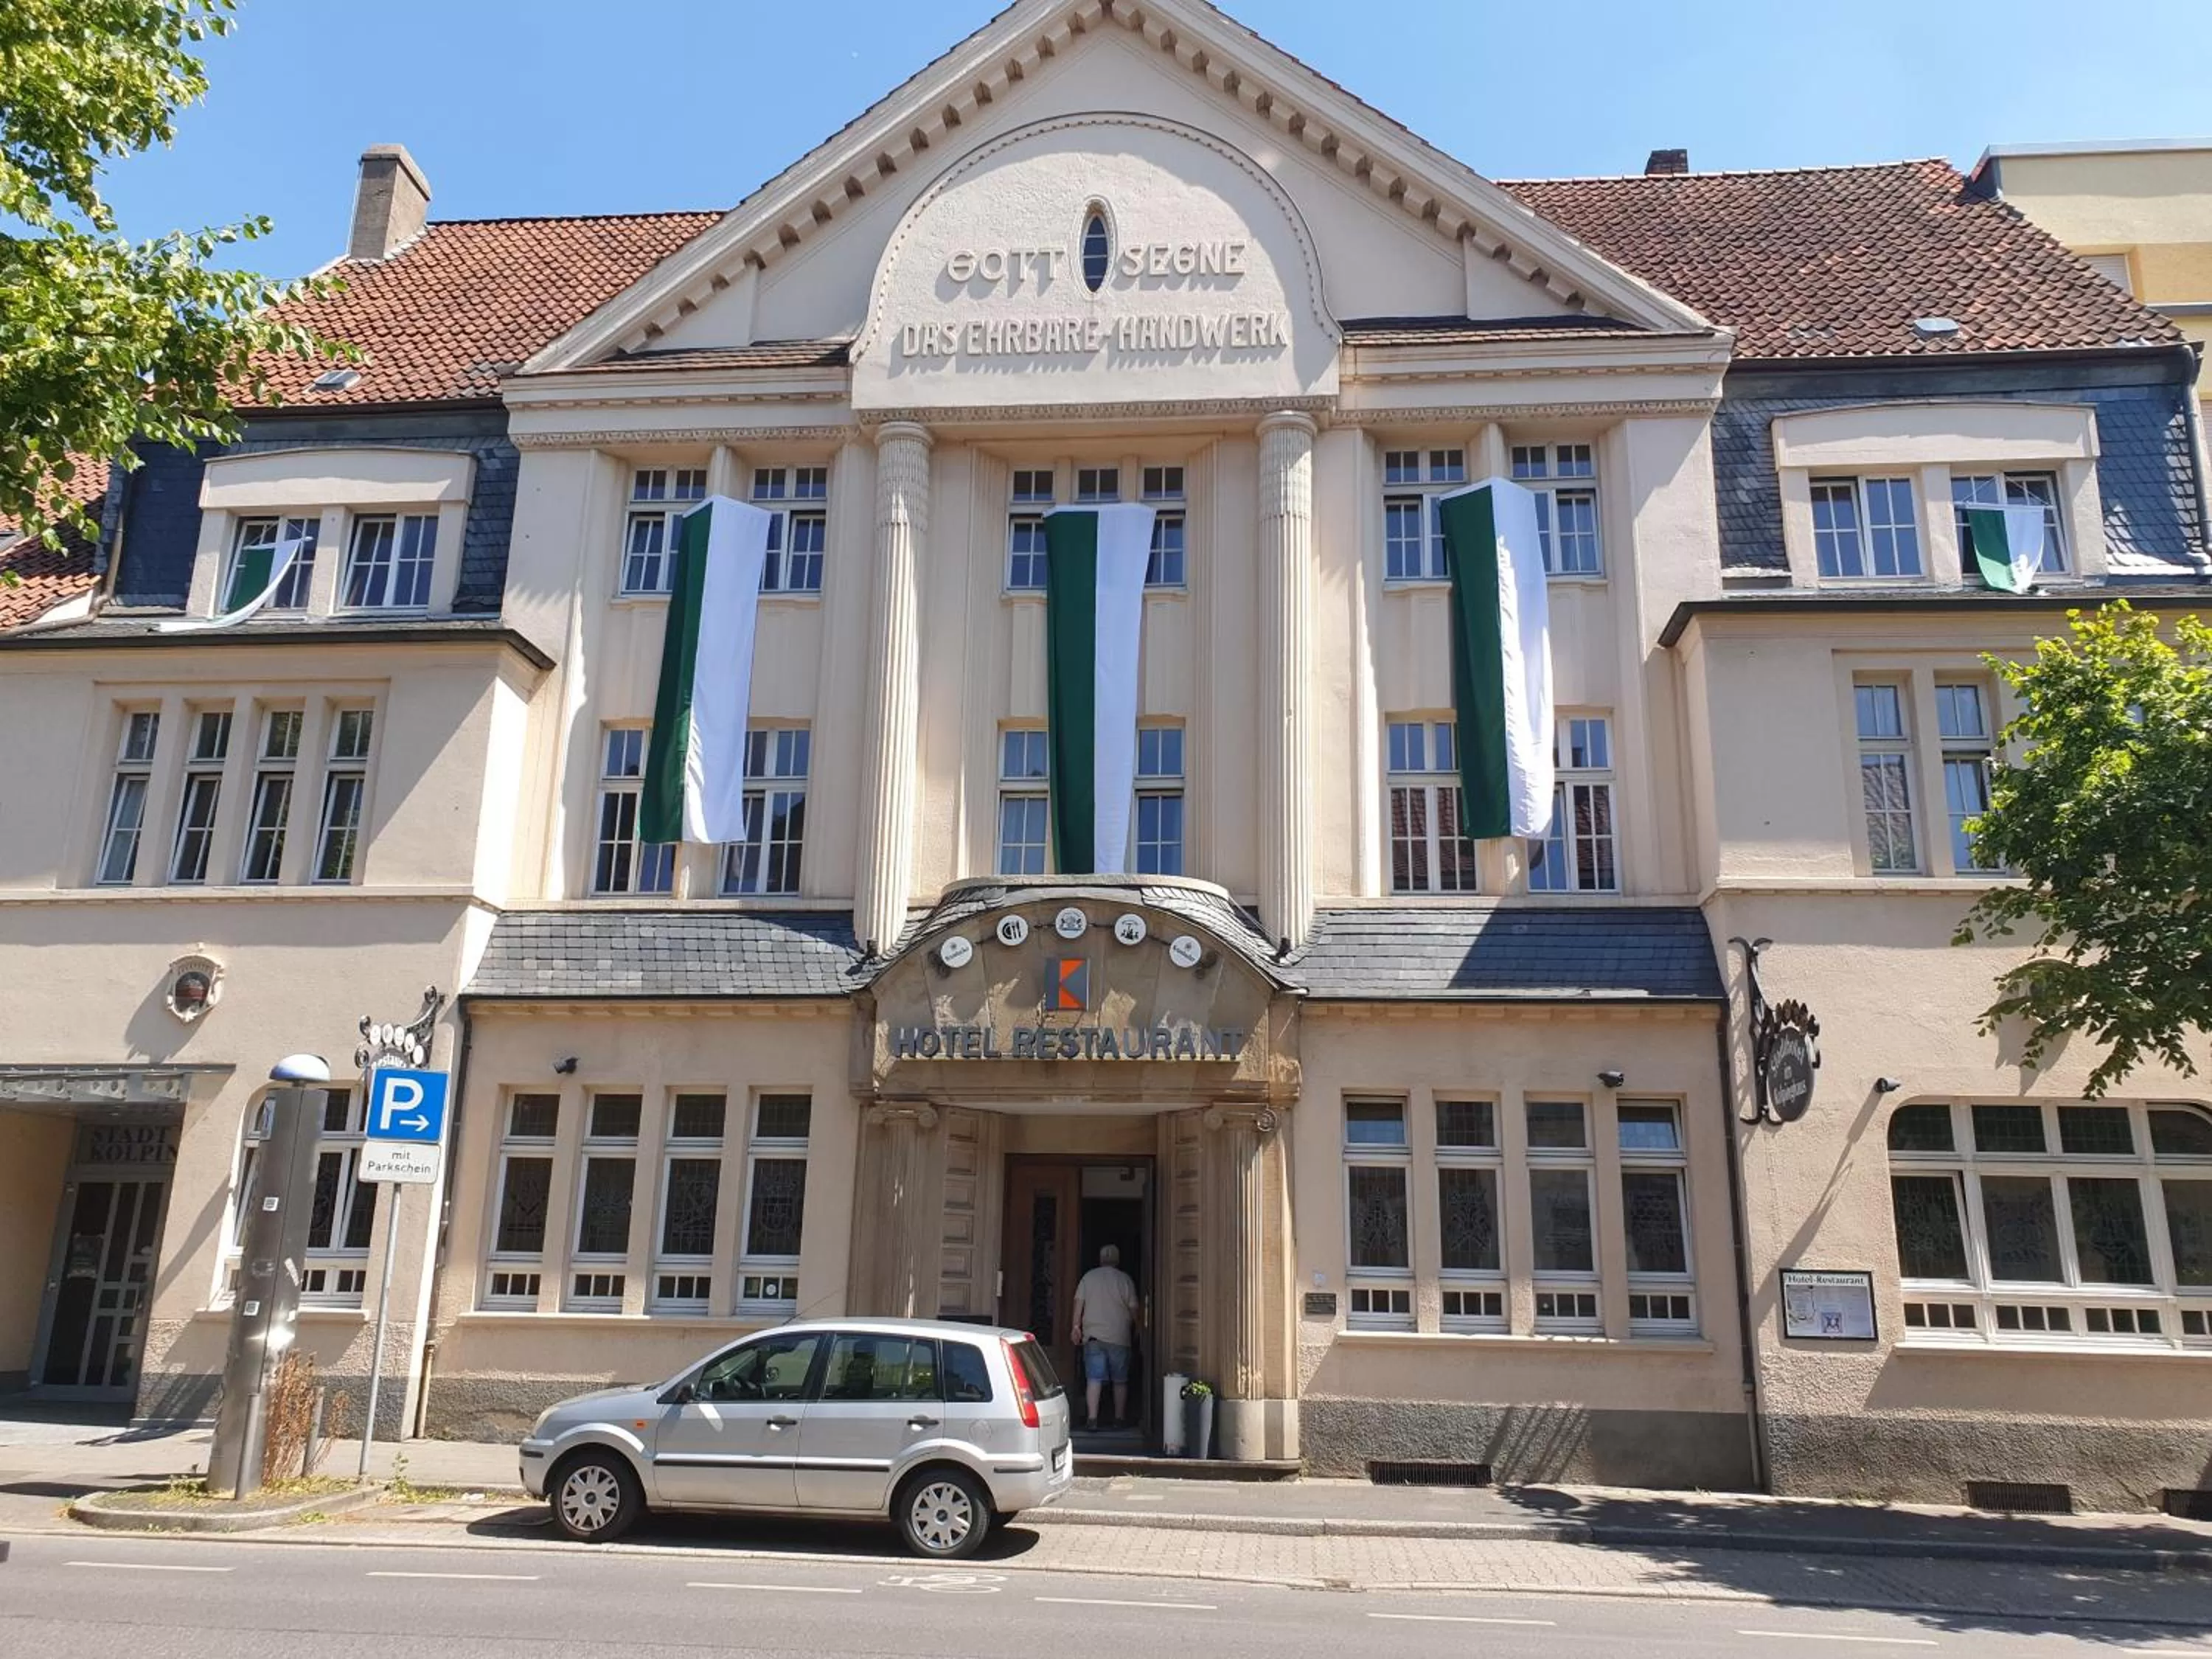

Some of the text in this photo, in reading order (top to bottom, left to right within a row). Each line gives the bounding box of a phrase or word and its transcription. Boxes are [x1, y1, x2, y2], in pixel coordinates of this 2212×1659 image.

[947, 241, 1246, 282] GOTT SEGNE
[902, 311, 1288, 357] DAS EHRBARE HANDWERK
[891, 1027, 1243, 1060] HOTEL RESTAURANT
[380, 1077, 424, 1130] P
[91, 1126, 170, 1143] STADT
[368, 1161, 431, 1174] Parkschein
[392, 1151, 411, 1160] mit
